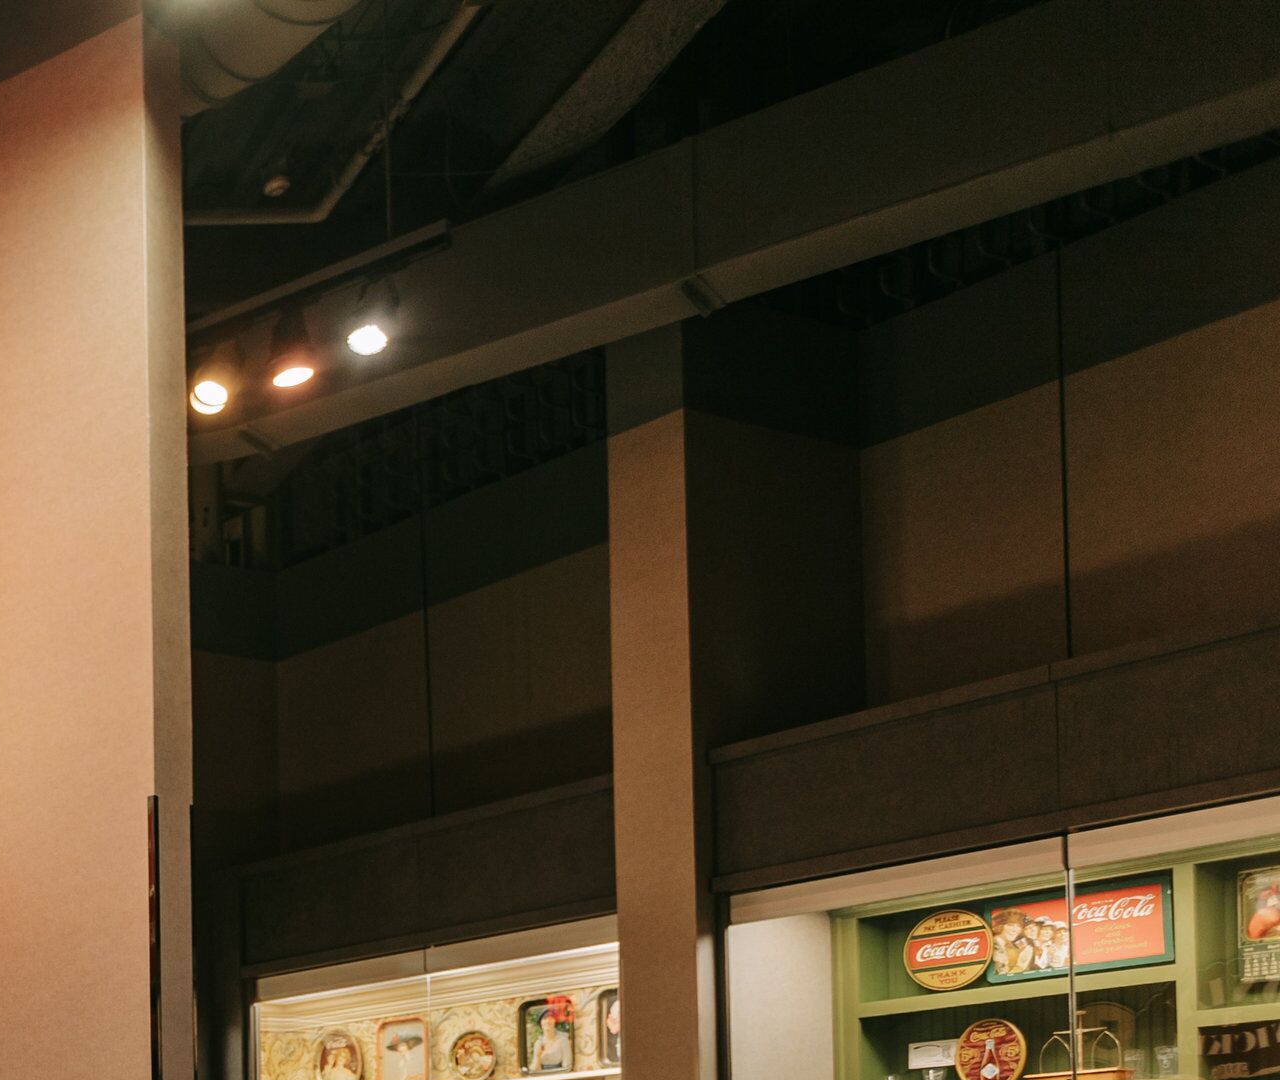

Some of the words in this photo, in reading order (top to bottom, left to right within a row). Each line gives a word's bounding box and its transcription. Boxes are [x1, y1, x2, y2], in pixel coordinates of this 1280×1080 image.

[1071, 893, 1156, 926] Coca-Cola
[915, 936, 981, 963] Coca-Cola
[931, 968, 967, 979] THANK
[939, 977, 958, 985] YOU
